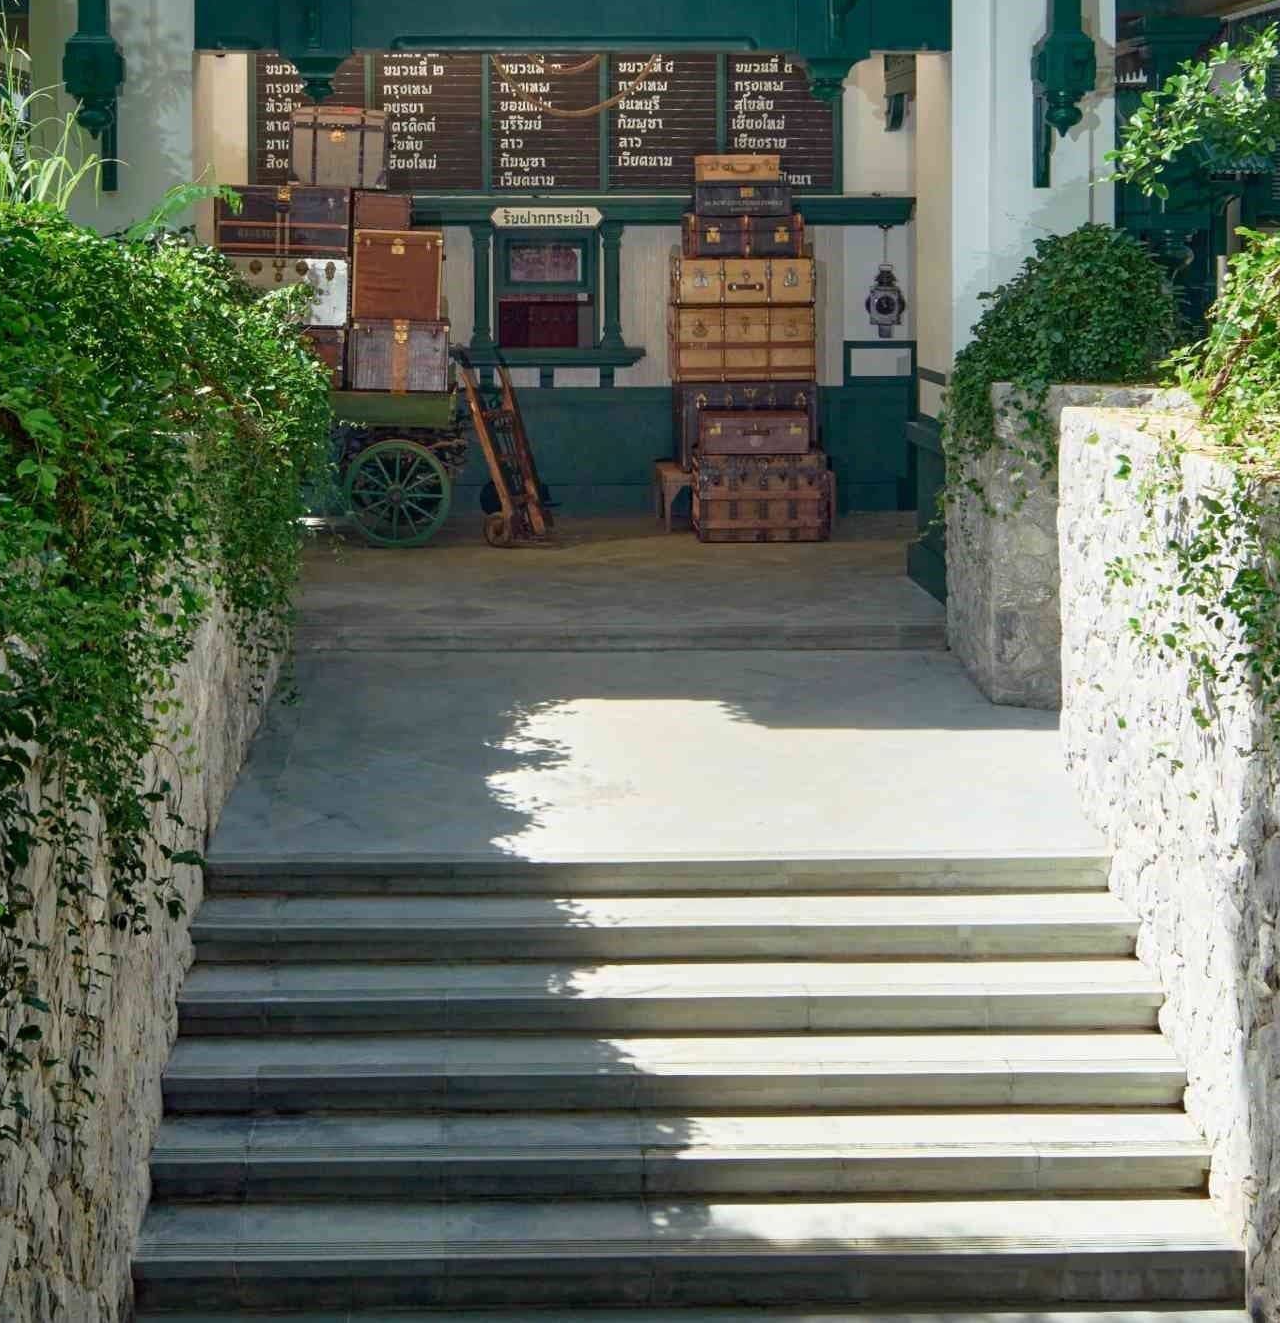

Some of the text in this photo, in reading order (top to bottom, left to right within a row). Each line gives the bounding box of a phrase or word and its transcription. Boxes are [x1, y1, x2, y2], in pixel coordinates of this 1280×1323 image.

[383, 57, 444, 76] ขบวนที่ ๒
[618, 54, 662, 73] ขบวที่
[735, 55, 779, 73] ขบวนที่
[383, 84, 433, 99] กรุงเทพ
[391, 116, 436, 132] ตรดิตถ์
[500, 115, 542, 135] บุรีรัมย์
[617, 113, 663, 133] กัมพูชา
[732, 113, 785, 130] เชียงใหม่
[500, 138, 523, 149] ลาว
[619, 136, 642, 148] ลาว
[734, 133, 787, 149] เชียงราย
[389, 154, 437, 169] ชียงใหม่
[500, 153, 546, 172] กัมพูชา
[618, 151, 673, 167] เวียดนาม
[500, 171, 555, 186] เวียดนาม
[503, 209, 590, 224] รับฝากกระเป๋า
